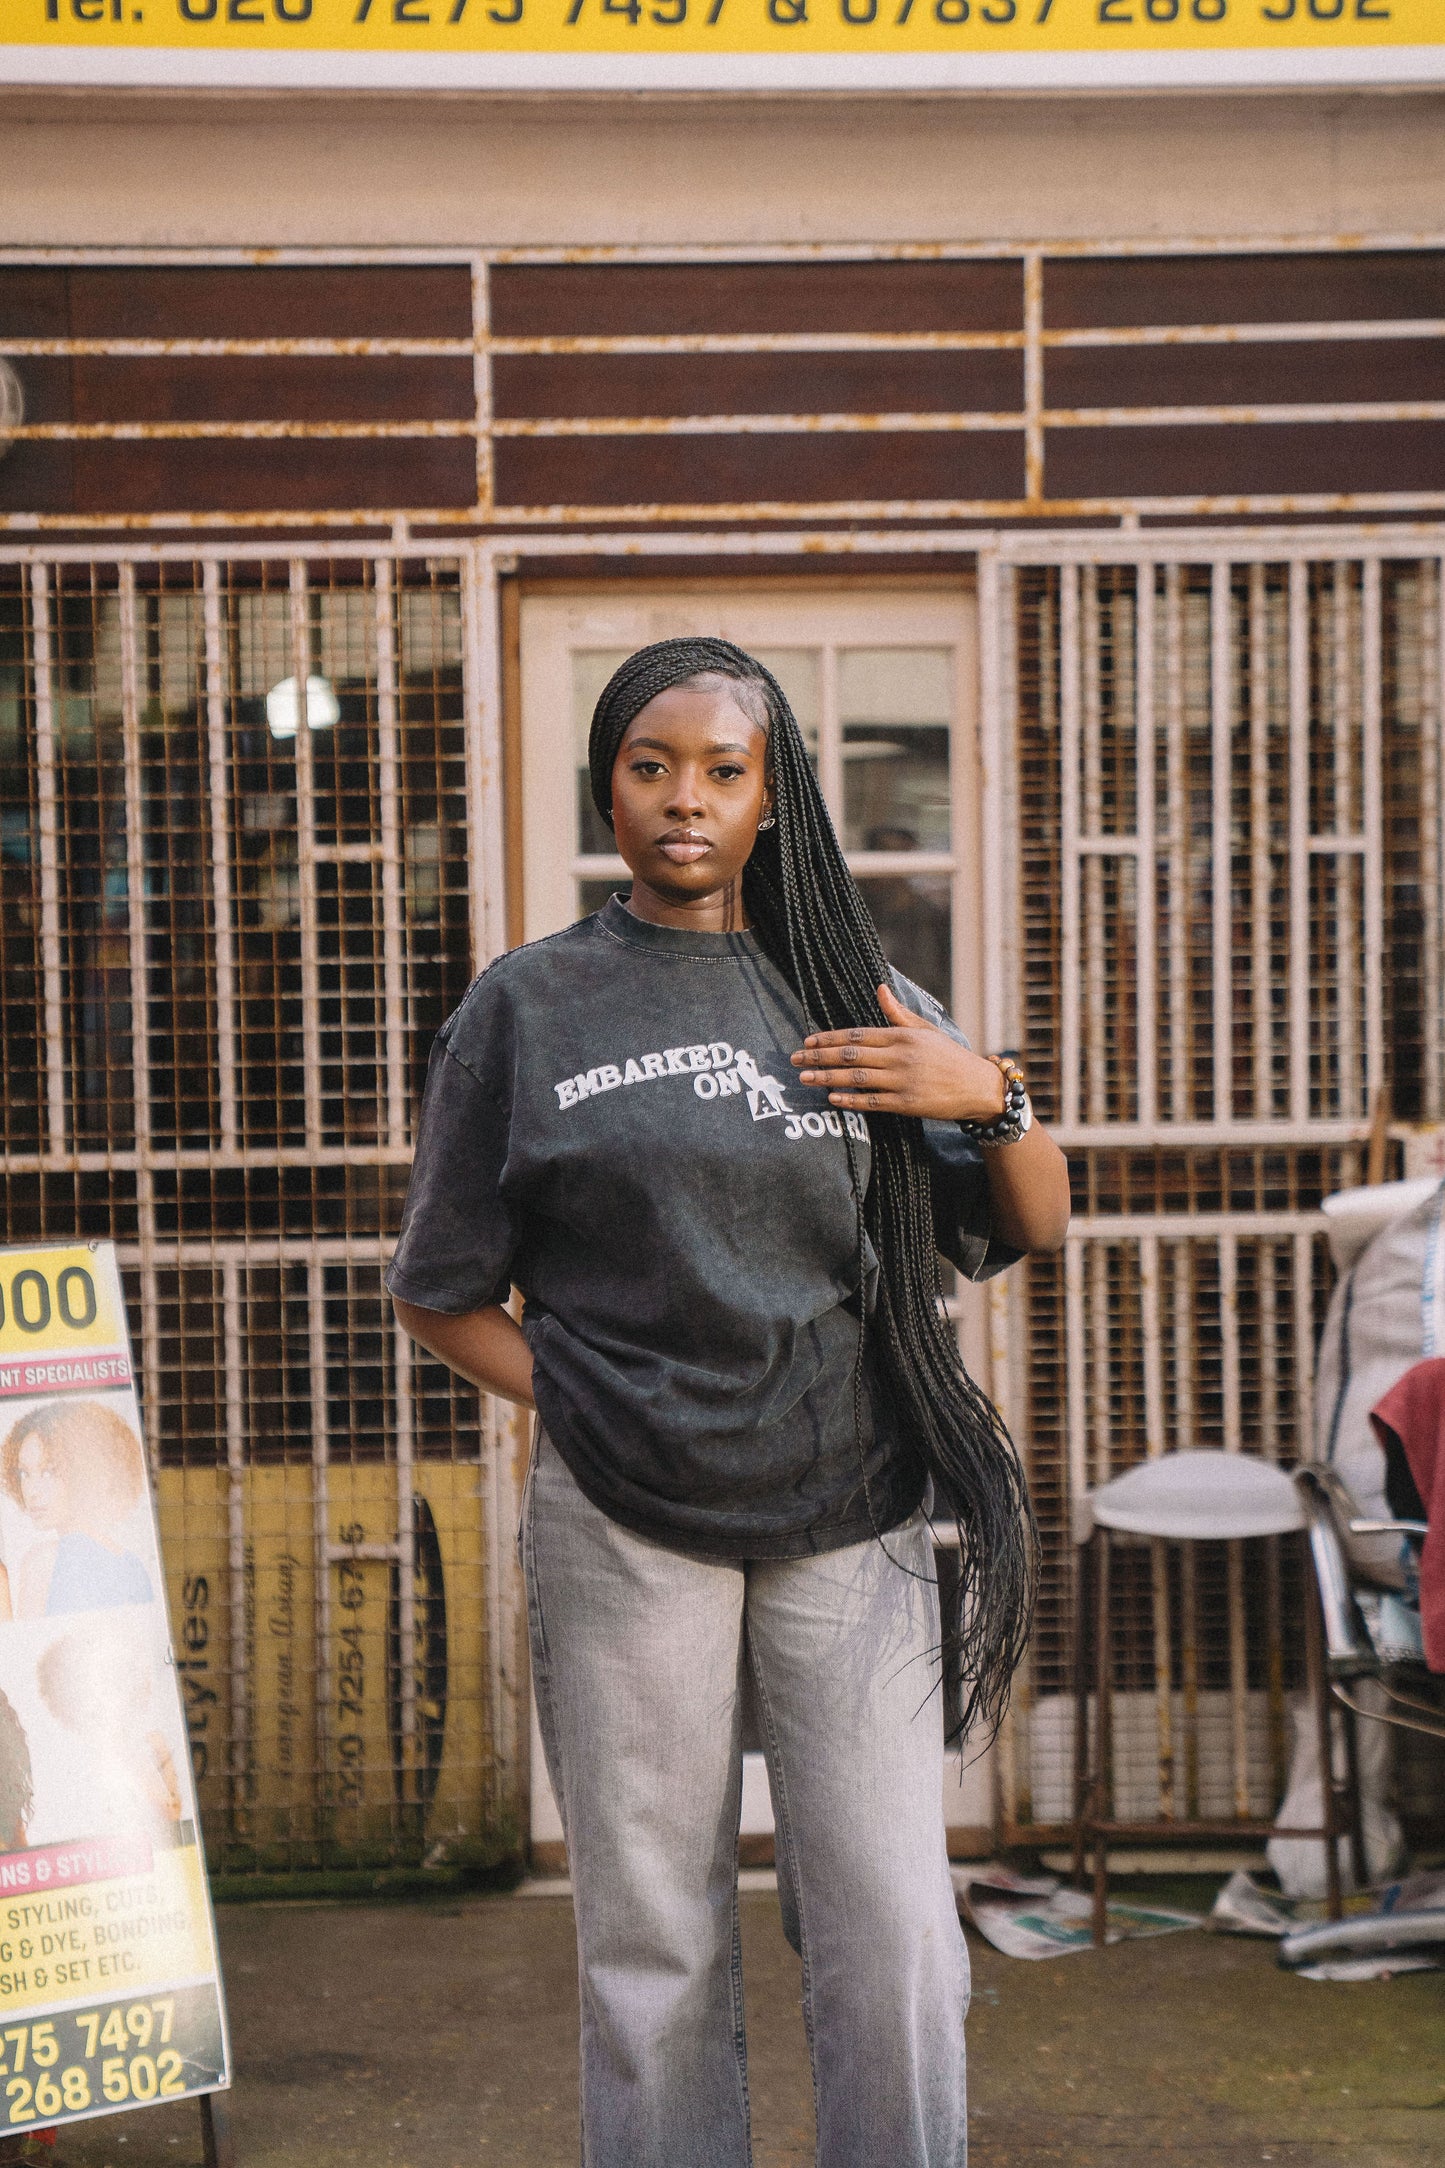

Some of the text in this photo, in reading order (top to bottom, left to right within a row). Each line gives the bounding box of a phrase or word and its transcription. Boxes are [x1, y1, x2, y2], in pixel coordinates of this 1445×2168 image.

[554, 1042, 735, 1111] EMBARKED
[694, 1068, 743, 1101] ON
[752, 1089, 780, 1119] A
[0, 1266, 97, 1333] 00
[25, 1360, 129, 1385] SPECIALISTS
[338, 1627, 365, 1720] 7254
[35, 1859, 51, 1882] &
[8, 1897, 98, 1929] STYLING,
[20, 1939, 33, 1959] &
[41, 1931, 86, 1955] DYE,
[35, 1968, 48, 1988] &
[55, 1959, 90, 1984] SET
[76, 1999, 175, 2058] 7497
[6, 2050, 186, 2123] 268 502
